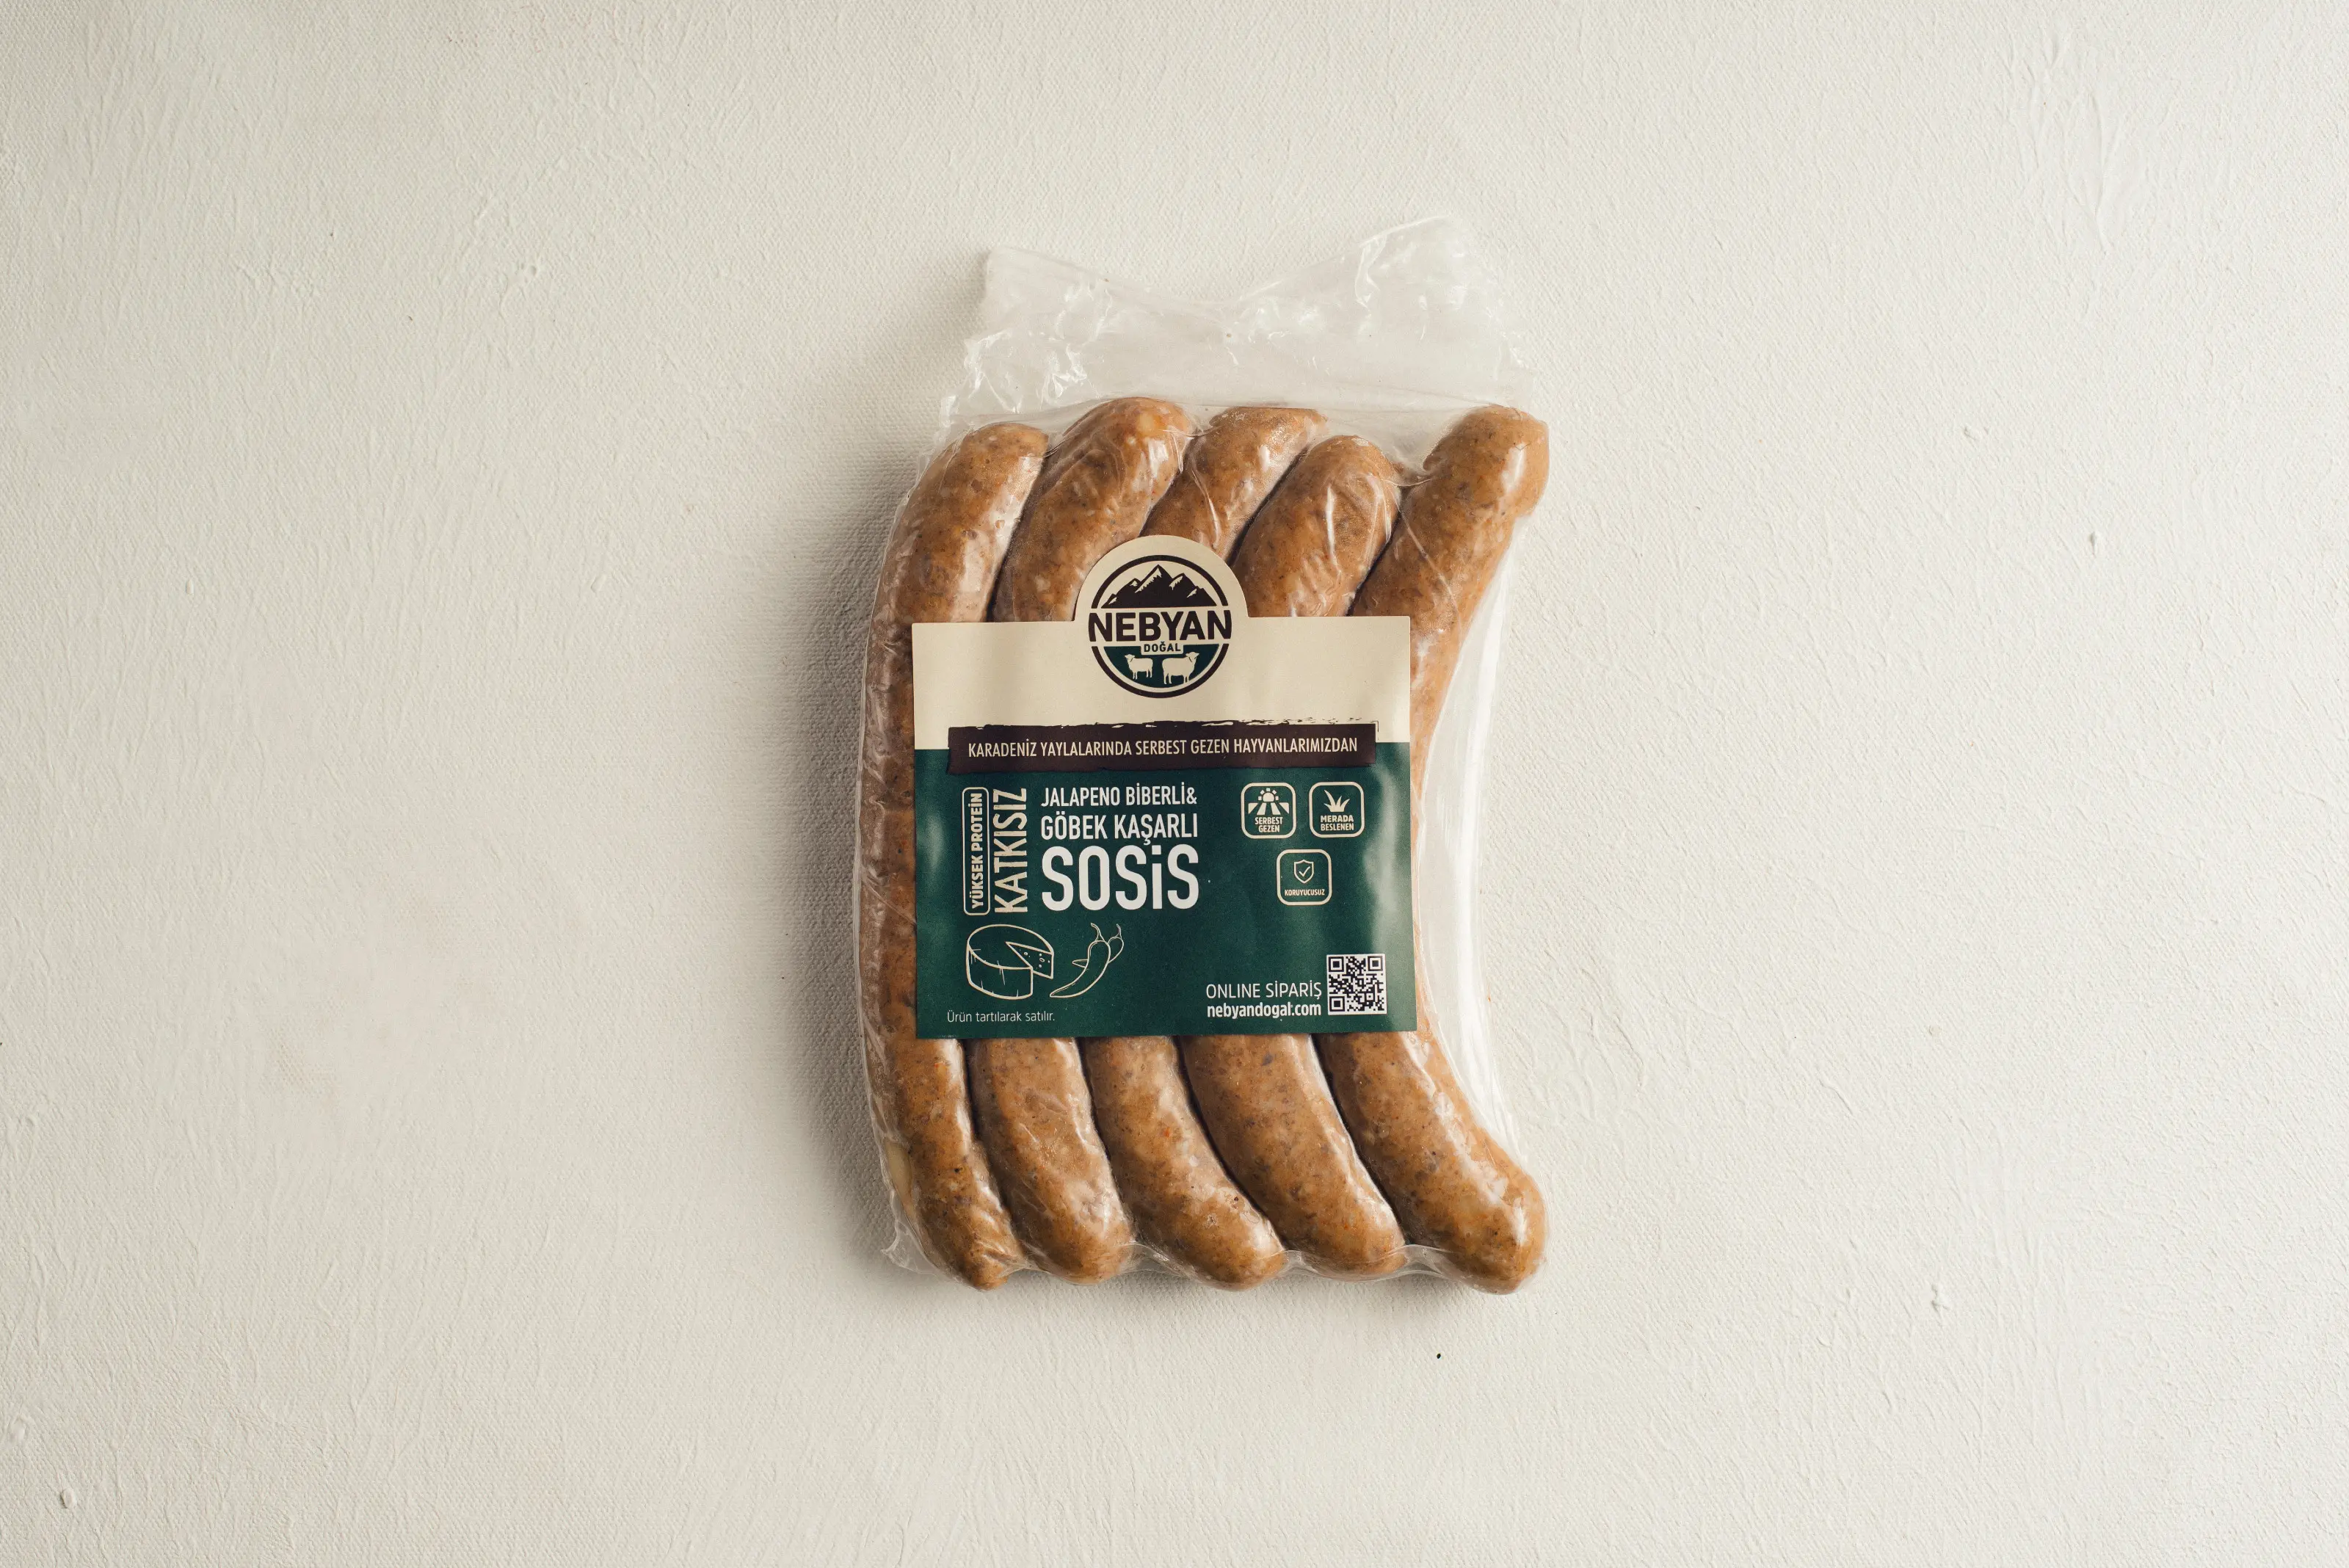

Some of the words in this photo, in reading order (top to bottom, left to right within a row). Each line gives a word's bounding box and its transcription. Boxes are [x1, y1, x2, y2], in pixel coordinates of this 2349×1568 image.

[1089, 610, 1232, 642] NEBYAN
[1144, 641, 1181, 653] DOĞAL
[968, 738, 1036, 757] KARADENİZ
[1040, 741, 1132, 756] YAYLALARINDA
[1135, 739, 1187, 755] SERBEST
[1191, 738, 1230, 754] GEZEN
[1234, 737, 1357, 753] HAYVANLARIMIZDAN
[1041, 787, 1120, 807] JALAPENO
[1125, 782, 1197, 805] BİBERLİ&
[967, 793, 983, 852] PROTEİN
[1041, 810, 1108, 840] GÖBEK
[1114, 813, 1198, 846] KAŞARLI
[1255, 816, 1283, 825] SERBEST
[1258, 824, 1280, 833] GEZEN
[1320, 815, 1354, 823] MERADA
[1321, 823, 1354, 831] BESLENEN
[992, 788, 1028, 912] KATKISIZ
[969, 854, 984, 909] YÜKSEK
[1284, 888, 1325, 896] KORUYUCUSUZ
[1206, 983, 1260, 999] ONLINE
[1266, 980, 1322, 1000] SİPARİŞ
[947, 1009, 972, 1023] Ürün
[976, 1011, 1022, 1022] tartılarak
[1025, 1010, 1056, 1022] satılır.
[1207, 1001, 1321, 1020] nebyandogal.com
